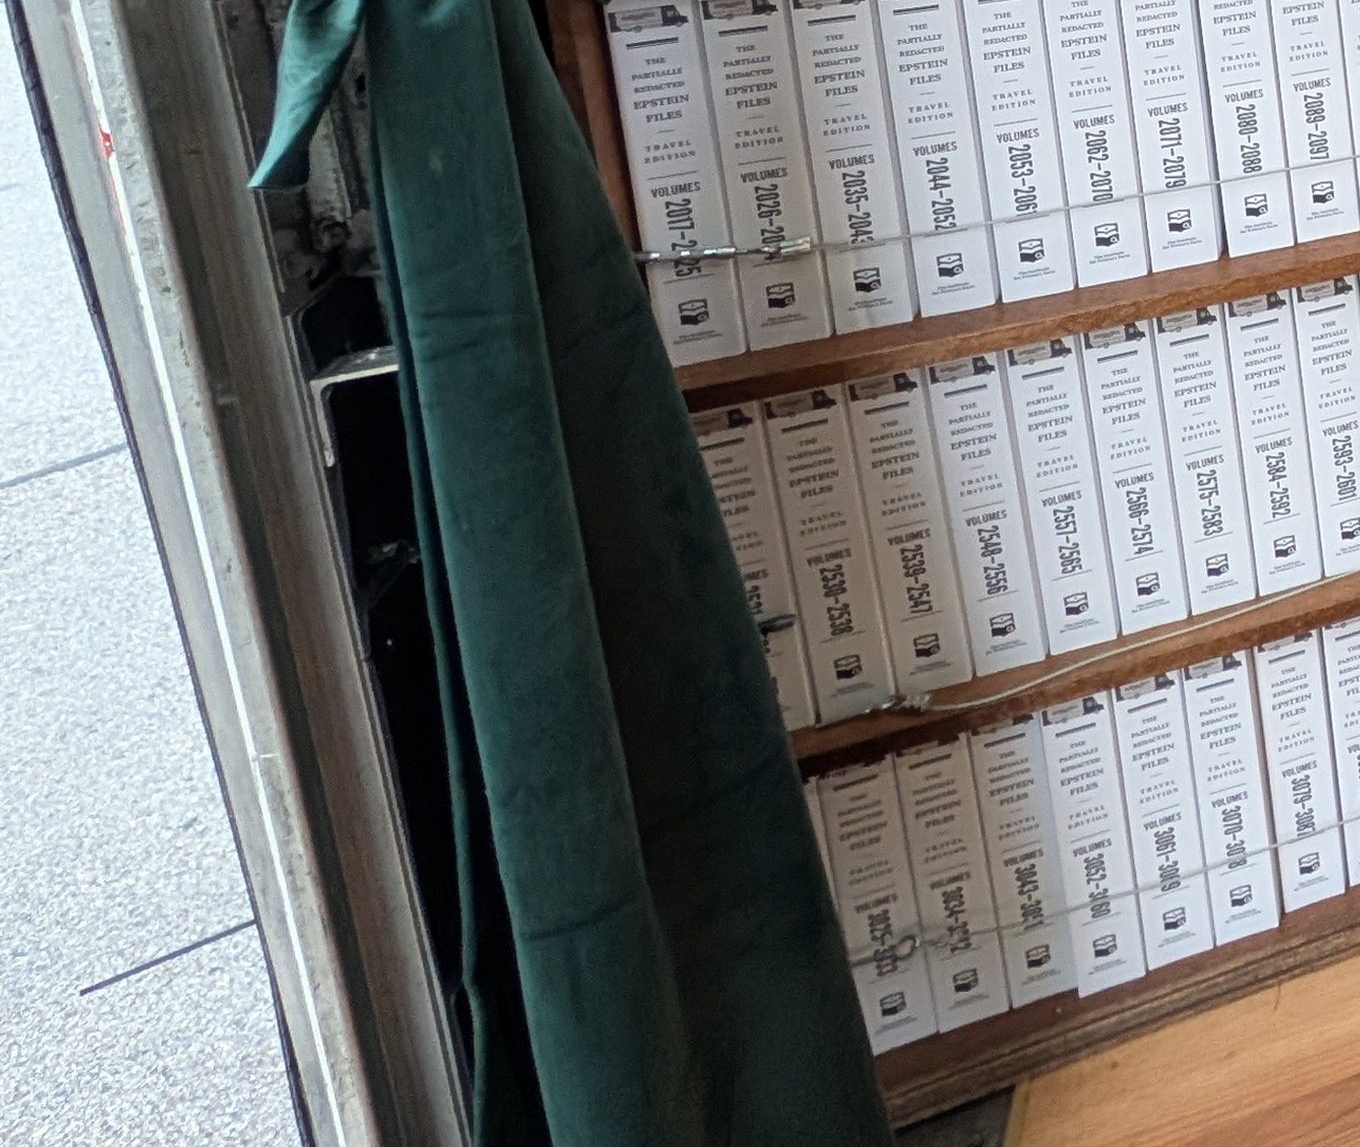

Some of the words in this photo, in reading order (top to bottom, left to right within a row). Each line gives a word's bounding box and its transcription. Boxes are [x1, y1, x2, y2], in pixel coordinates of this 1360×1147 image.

[1213, 0, 1254, 11] REDACTED
[1213, 11, 1257, 25] EPSTEIN
[1222, 24, 1252, 36] FILES
[1221, 52, 1257, 63] TRAVEL
[1221, 62, 1261, 73] EDITION
[1225, 89, 1264, 103] VOLUMES
[1302, 91, 1331, 160] 2089-2097
[1234, 102, 1265, 175] 2080-2088
[1244, 368, 1287, 381] EPSTEIN
[1252, 378, 1282, 392] FILES
[1252, 404, 1288, 415] TRAVEL
[1250, 413, 1290, 425] EDITION
[1255, 438, 1293, 453] VOLUMES
